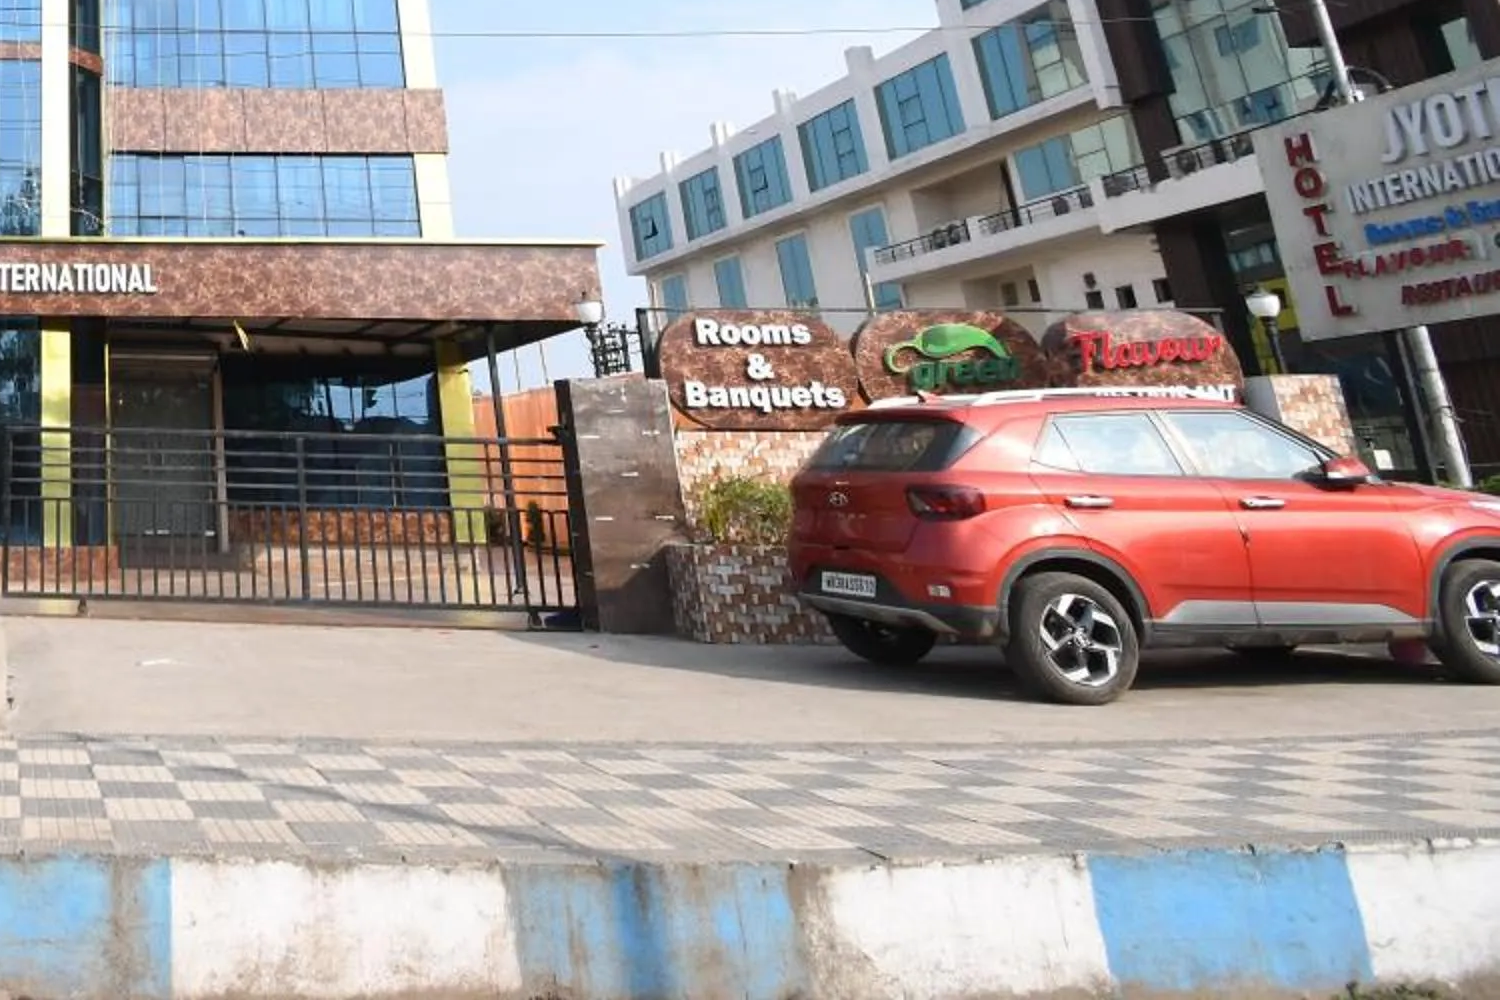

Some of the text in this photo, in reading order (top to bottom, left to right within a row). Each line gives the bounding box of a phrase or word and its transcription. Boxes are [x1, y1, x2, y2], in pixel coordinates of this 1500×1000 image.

[1284, 132, 1353, 317] HOTEL
[695, 318, 812, 345] Rooms
[747, 353, 775, 379] &
[1071, 330, 1221, 374] Flavour
[911, 360, 1020, 391] green
[685, 380, 846, 413] Banquets
